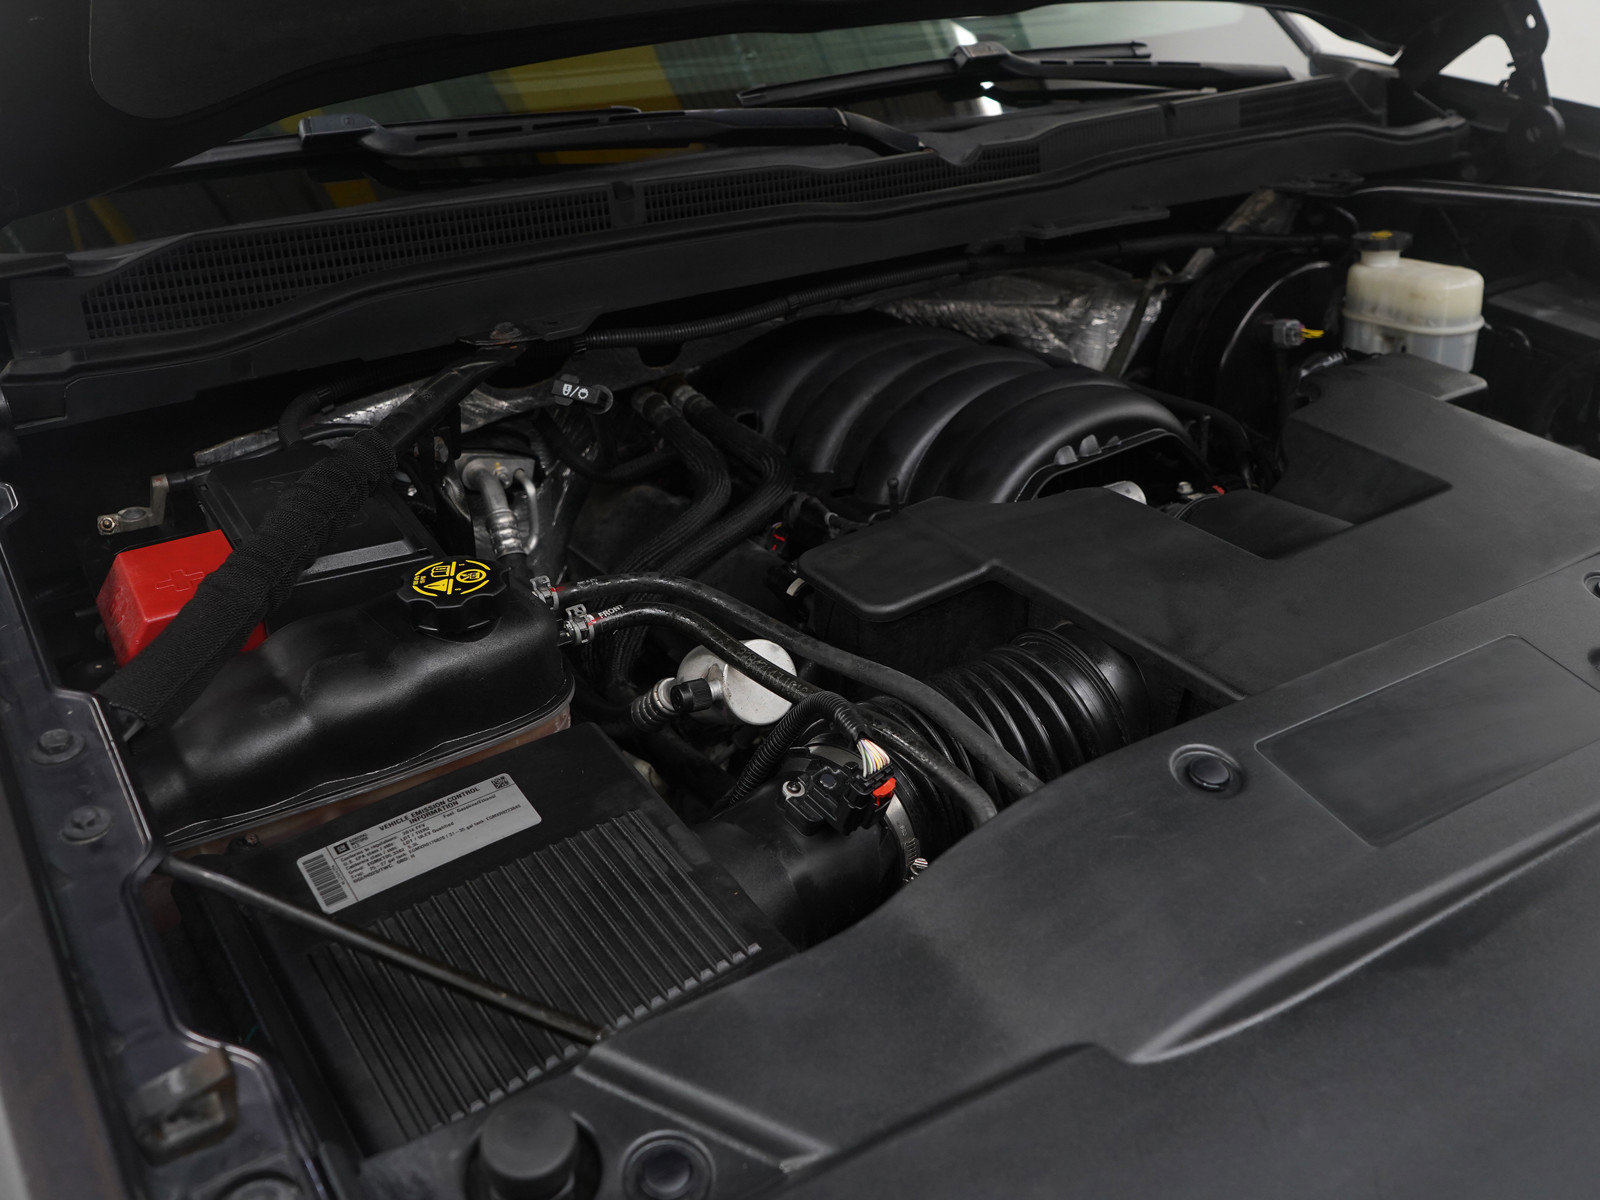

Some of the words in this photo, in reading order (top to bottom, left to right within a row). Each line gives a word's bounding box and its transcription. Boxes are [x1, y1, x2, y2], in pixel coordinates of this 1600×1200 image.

[598, 604, 624, 618] FRONT
[379, 815, 410, 831] VEHICLE
[410, 800, 446, 818] EMISSION
[447, 786, 480, 803] CONTROL
[409, 800, 459, 825] INFORMATION
